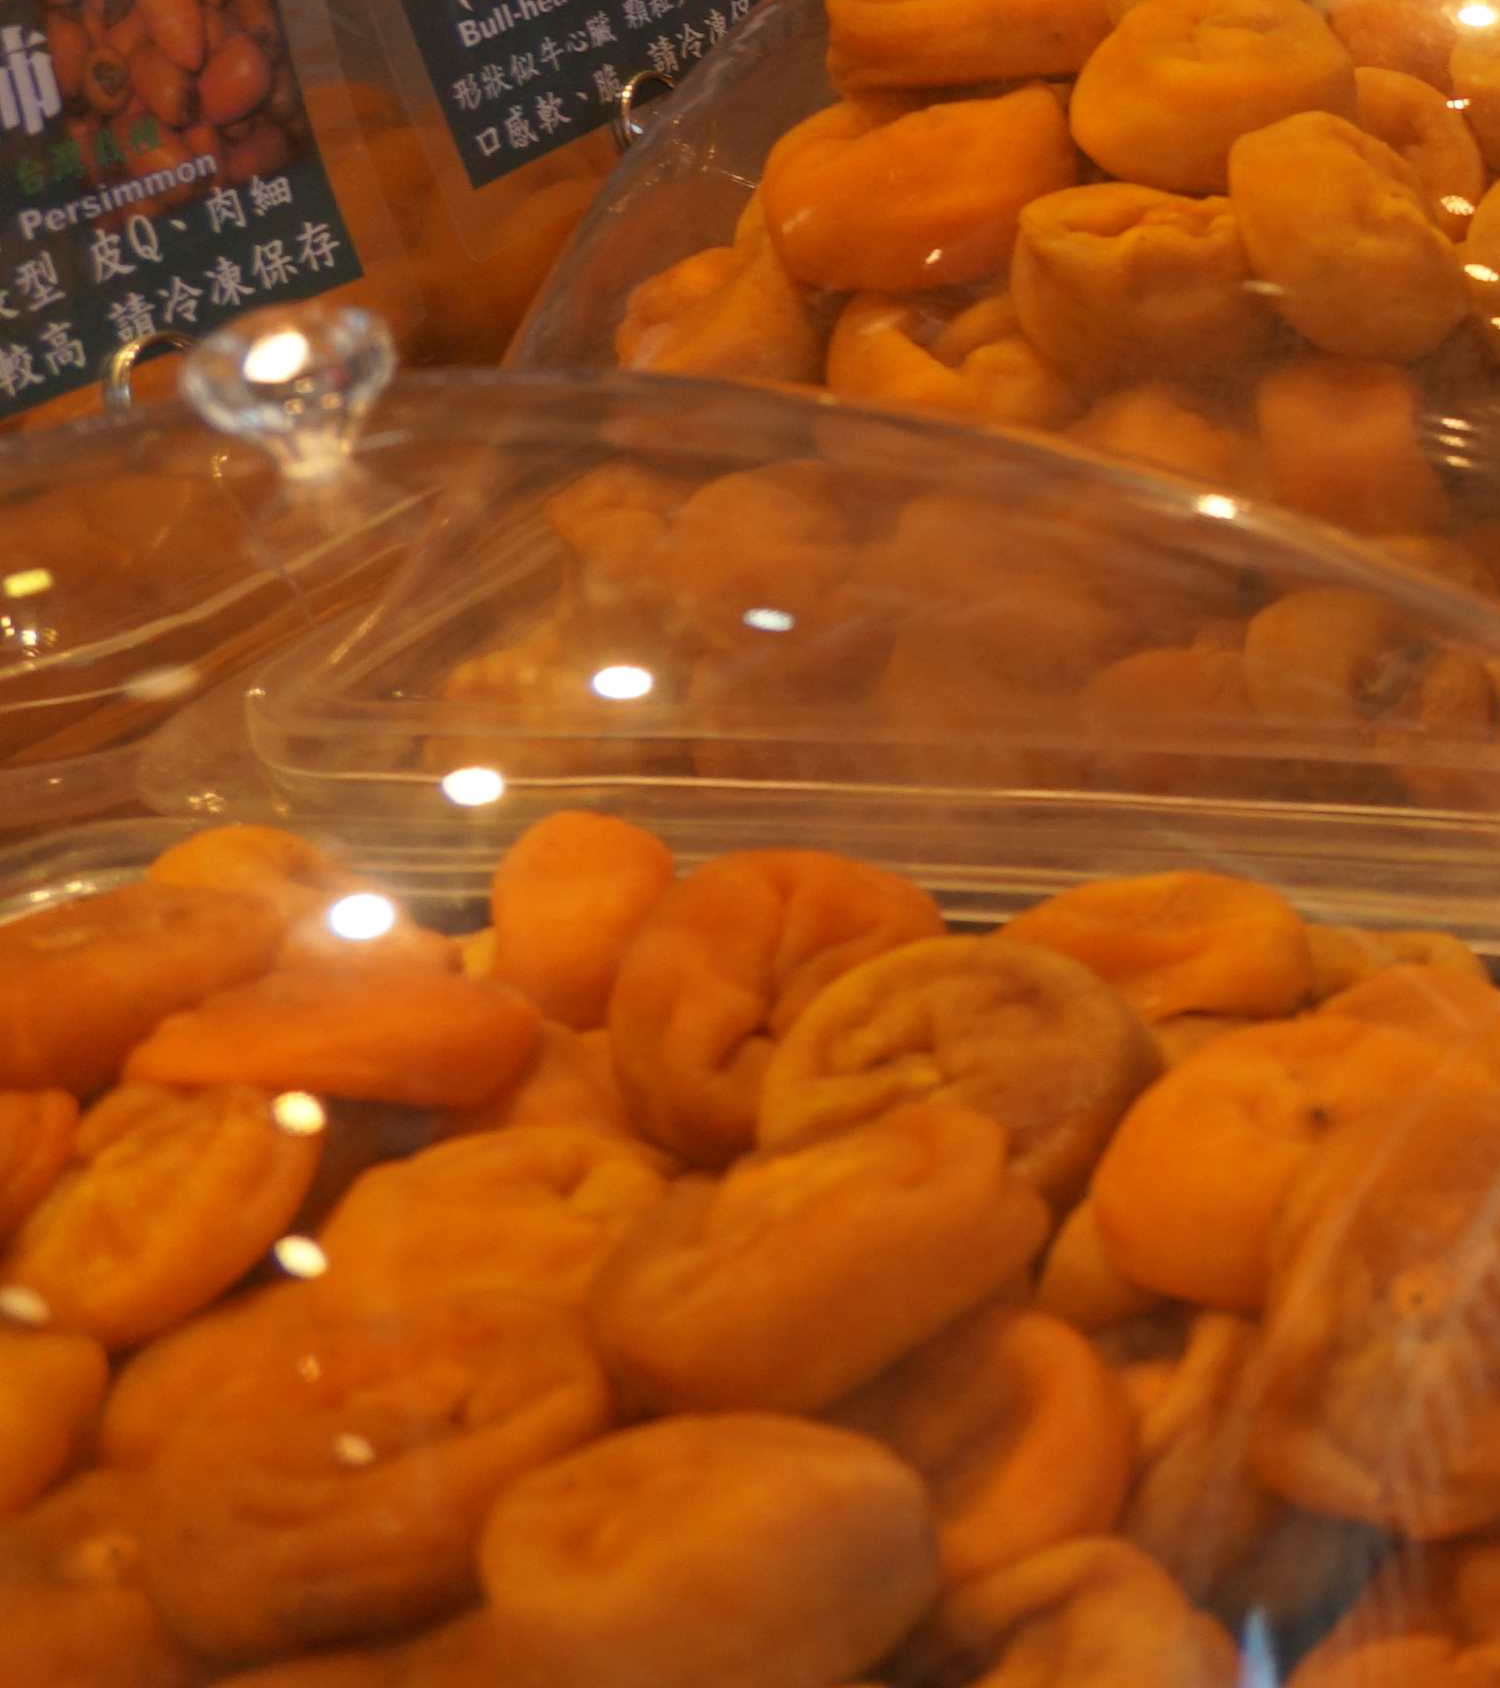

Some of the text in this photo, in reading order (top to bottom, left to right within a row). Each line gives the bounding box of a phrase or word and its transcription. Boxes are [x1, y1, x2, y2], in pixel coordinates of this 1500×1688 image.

[19, 152, 218, 242] Persimmon
[109, 220, 343, 345] 請冷凍保存
